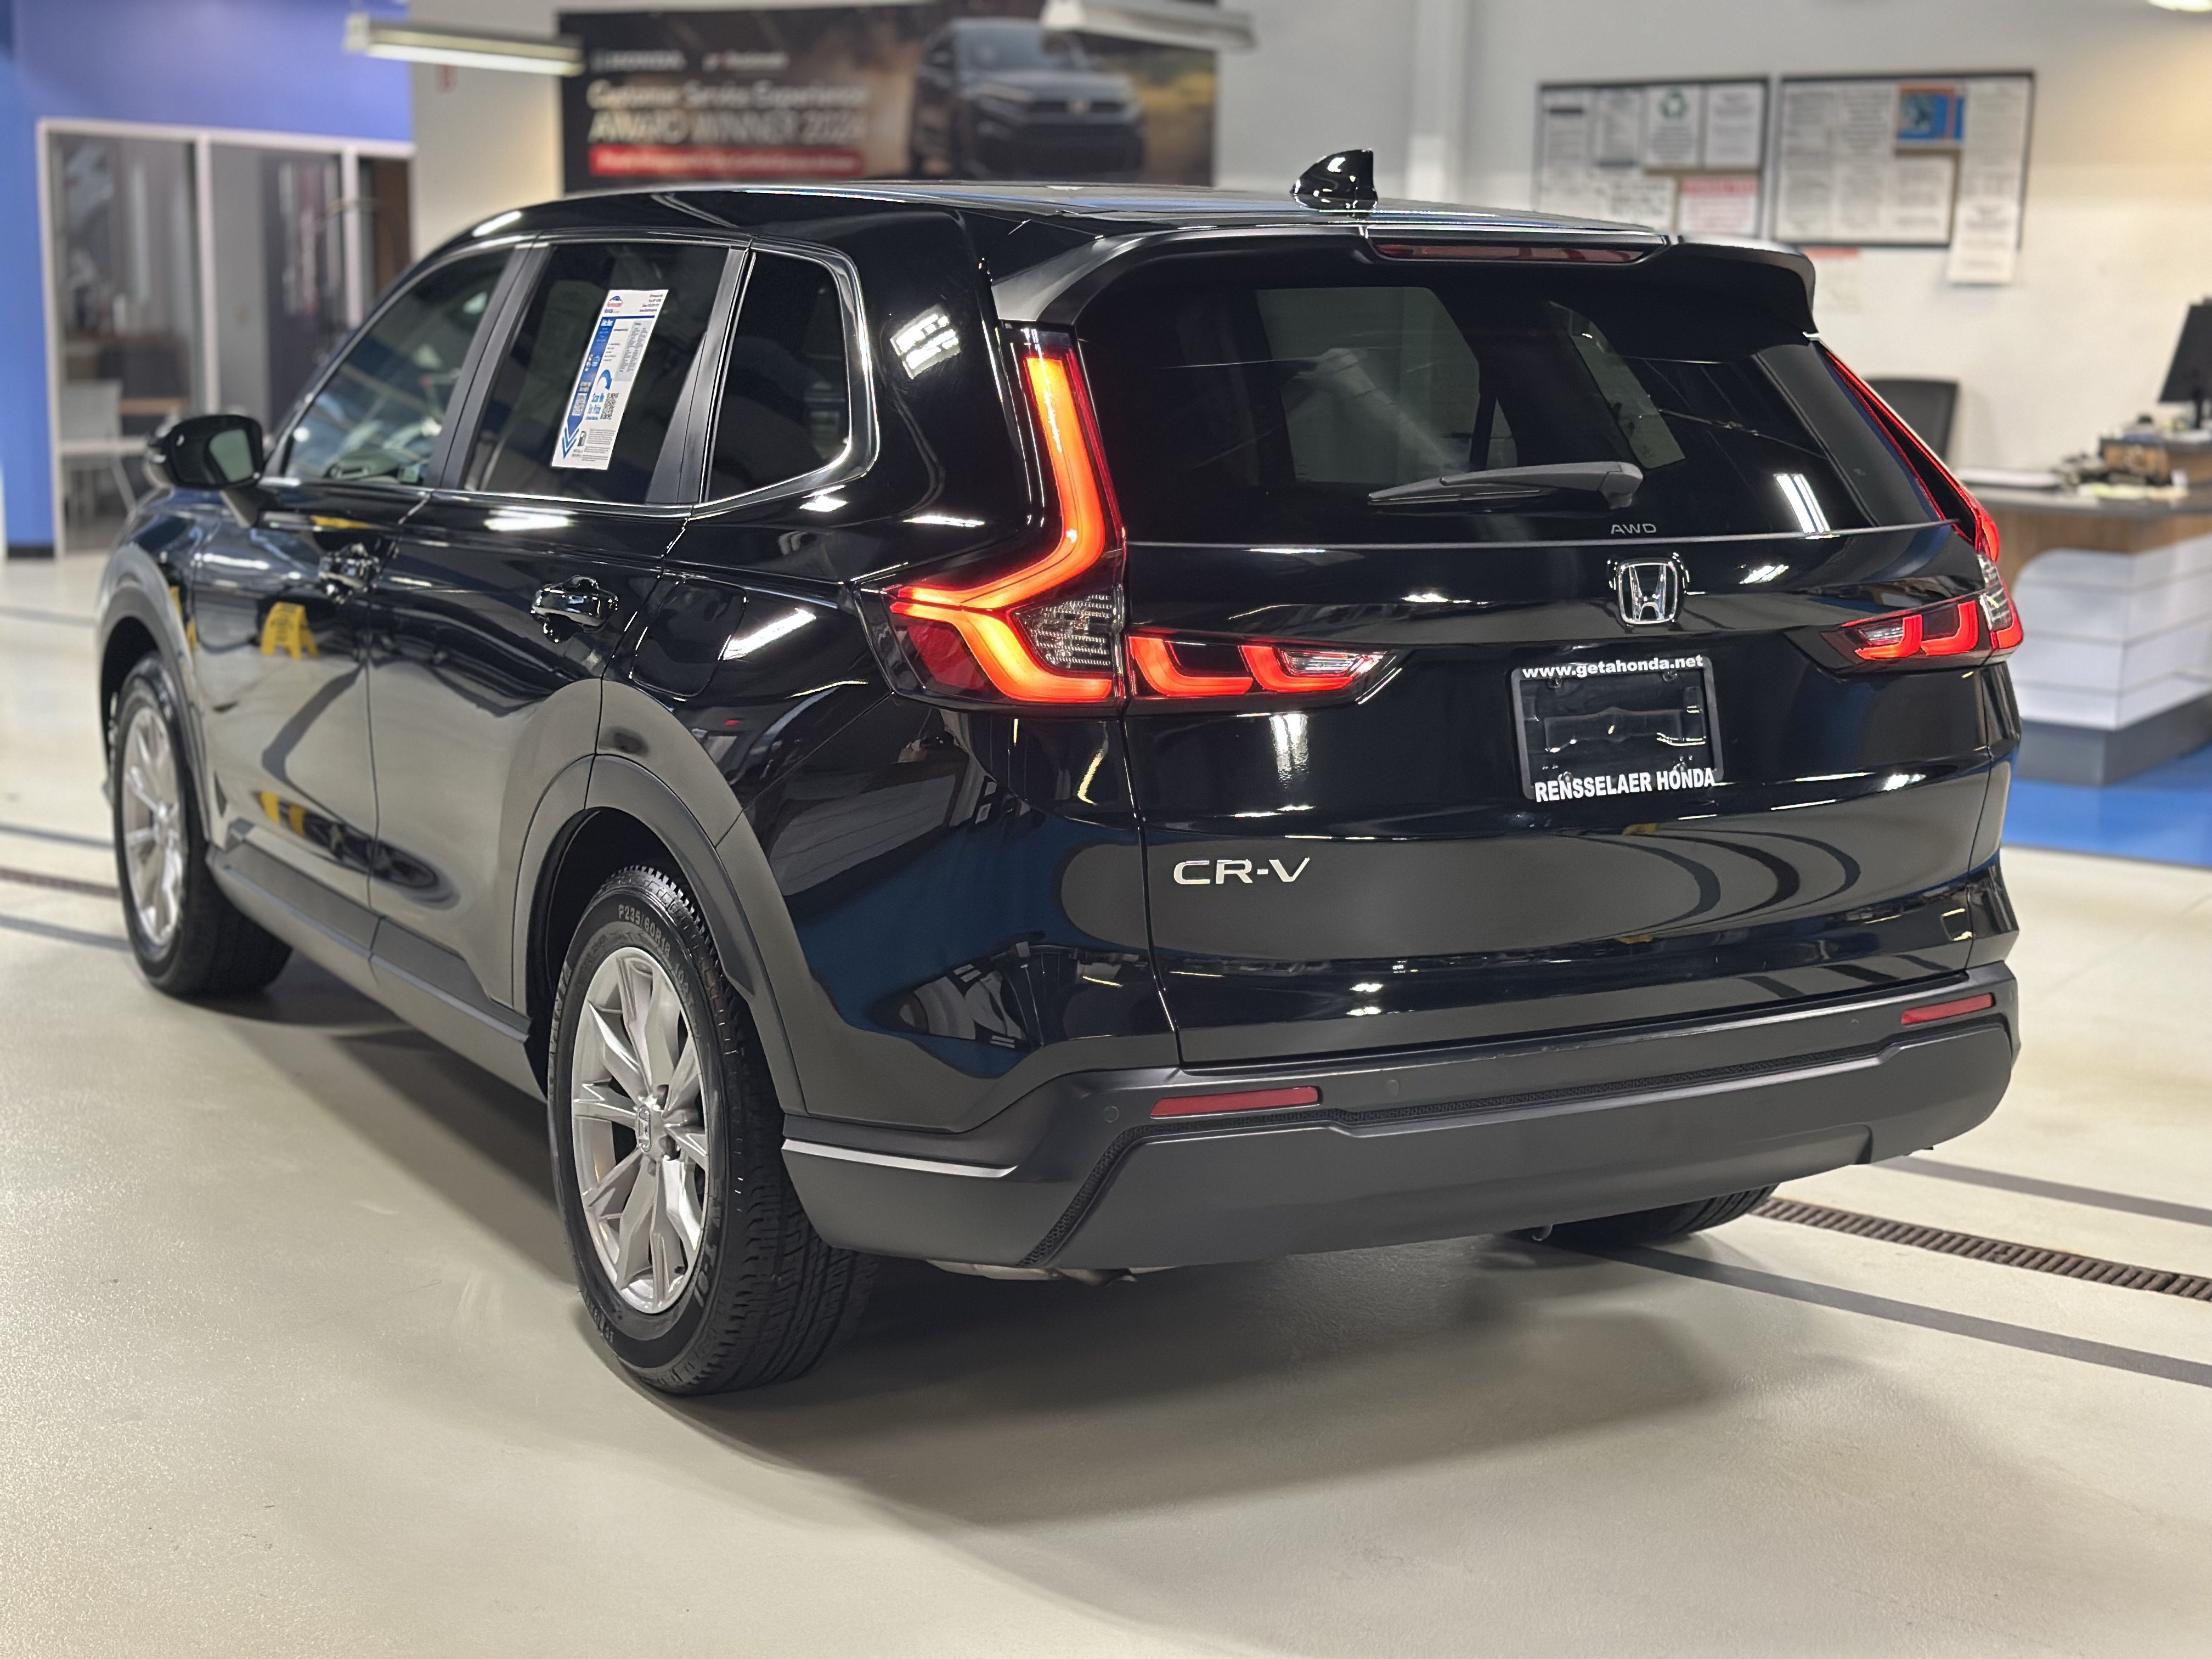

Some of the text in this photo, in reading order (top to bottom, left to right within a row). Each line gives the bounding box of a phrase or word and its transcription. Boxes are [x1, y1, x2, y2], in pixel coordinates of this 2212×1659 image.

[1611, 523, 1657, 534] AWD
[1522, 654, 1703, 678] www.getahonda.net
[1535, 768, 1715, 802] RENSSELAER HONDA
[1173, 857, 1310, 884] CR-V
